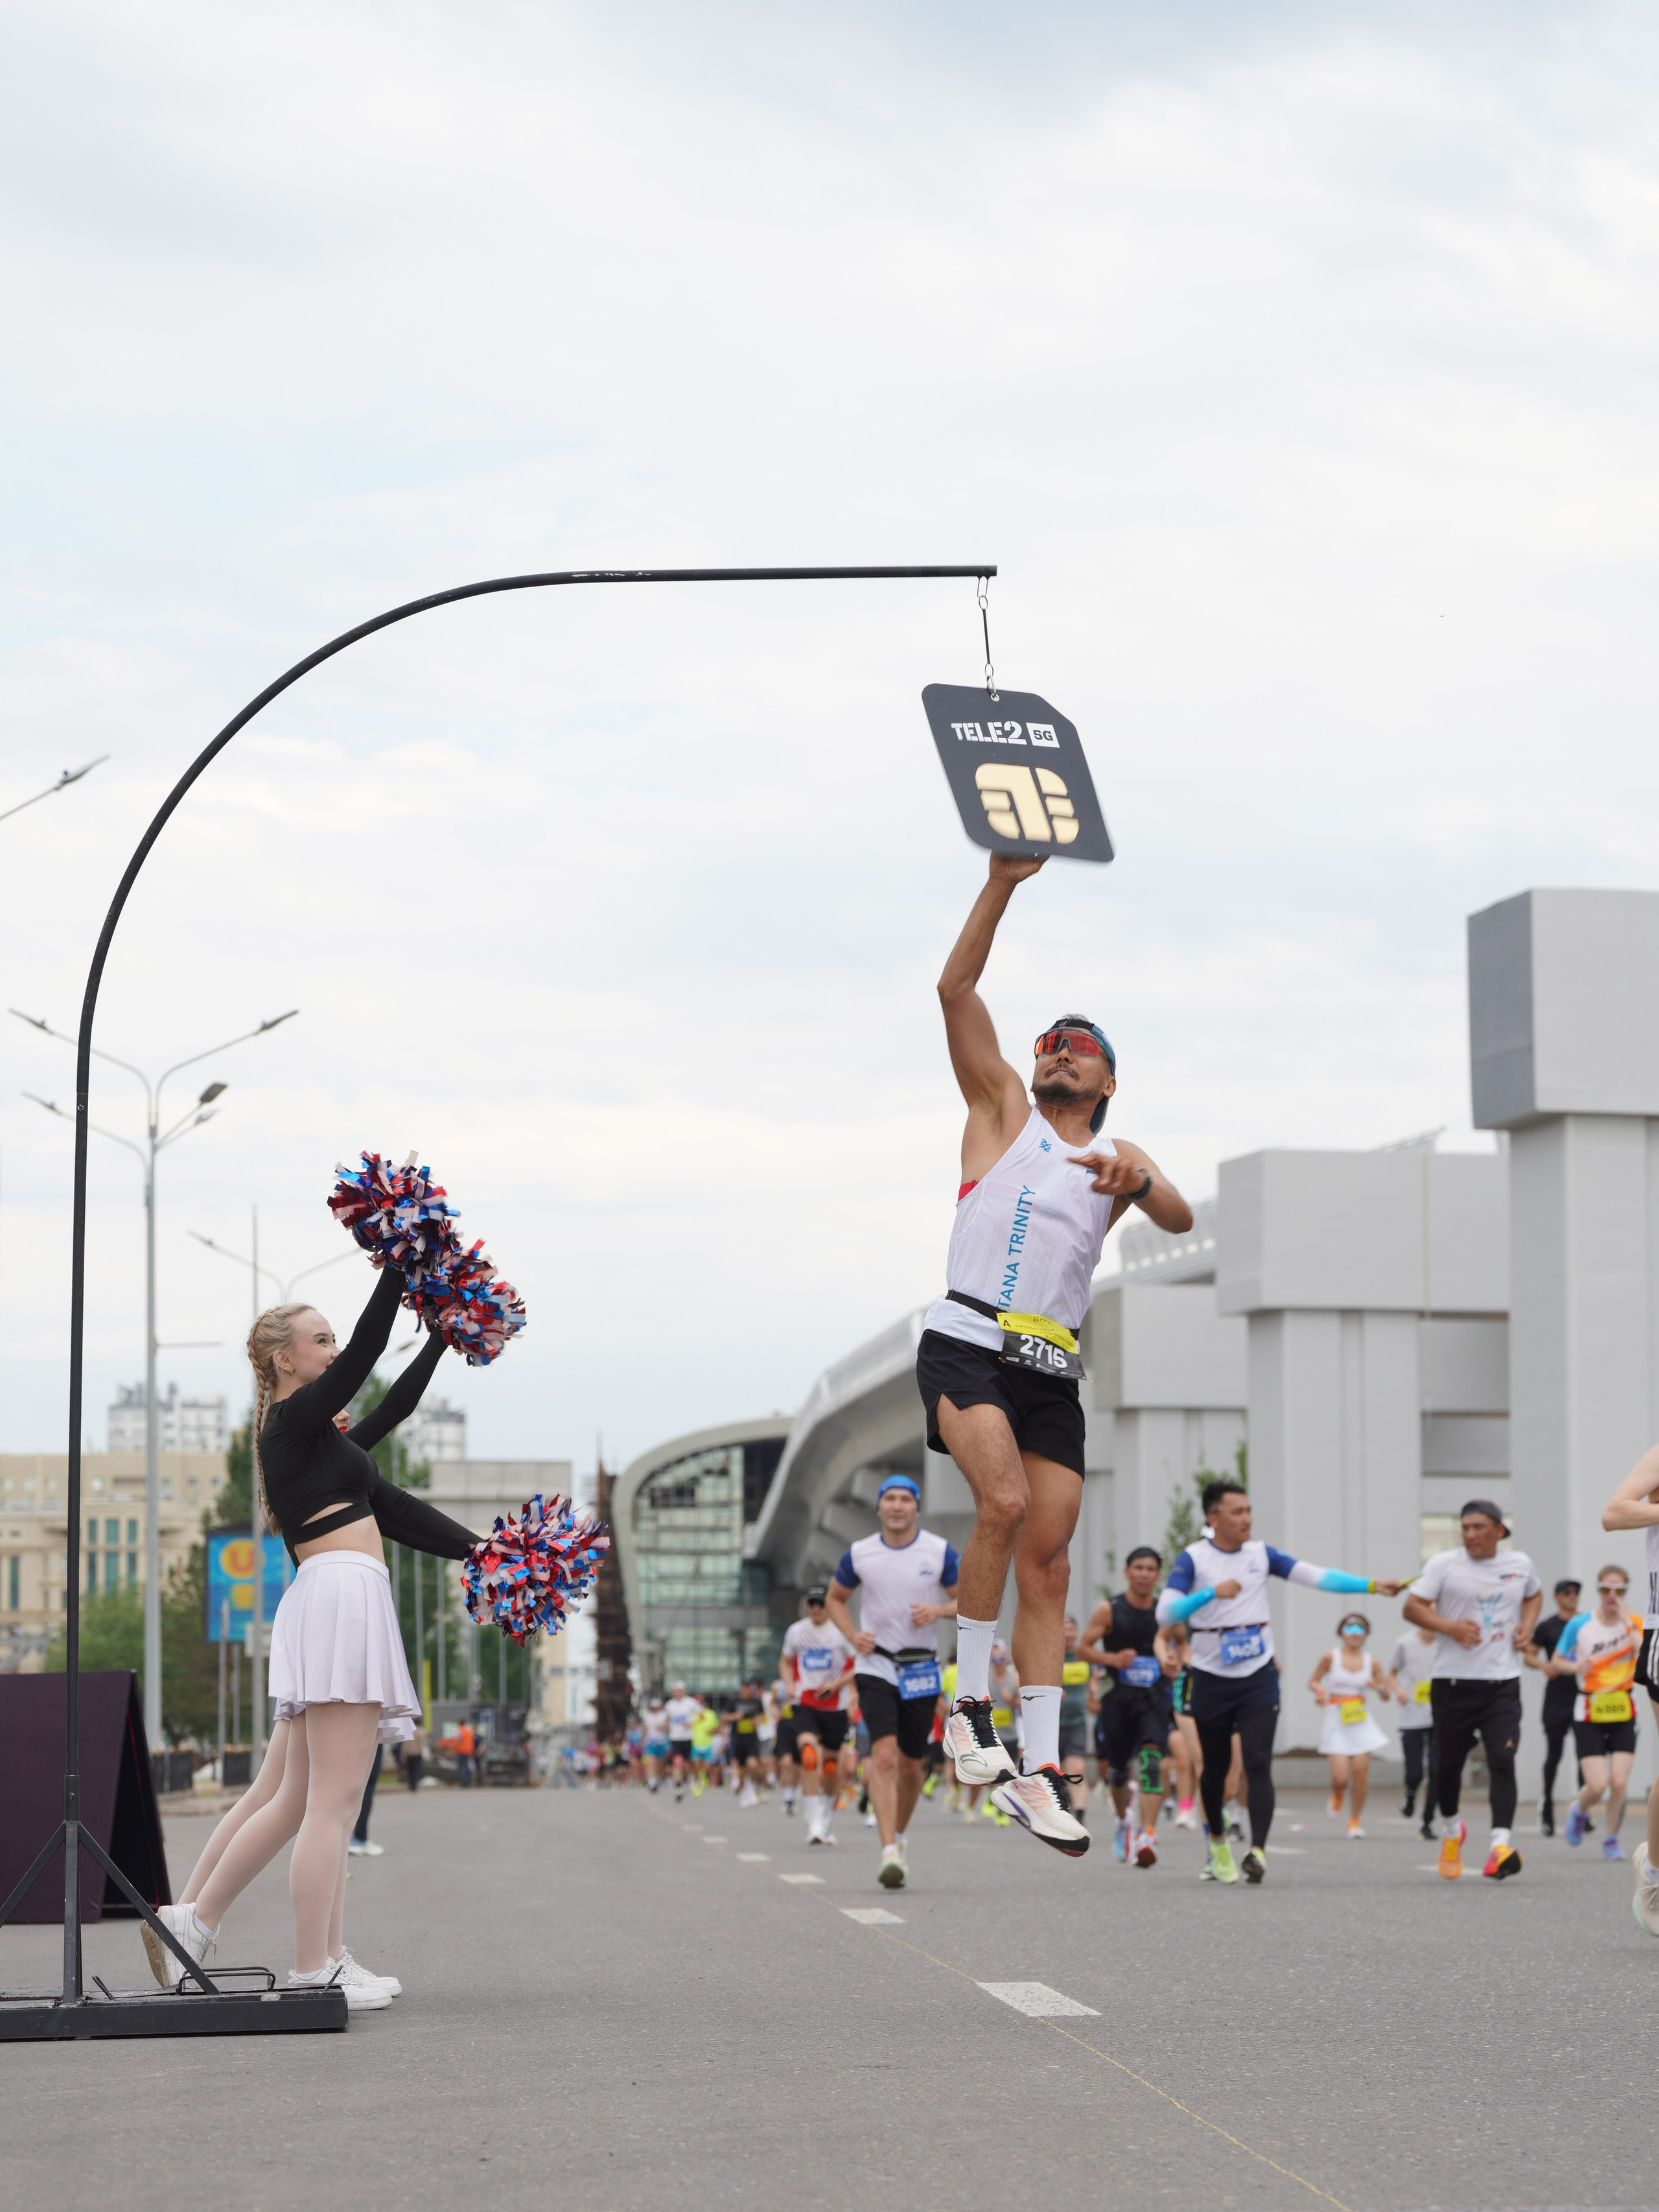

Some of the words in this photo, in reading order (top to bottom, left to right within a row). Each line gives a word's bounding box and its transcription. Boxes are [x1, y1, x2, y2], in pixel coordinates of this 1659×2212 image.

[951, 721, 1027, 745] TELE2
[1033, 730, 1054, 741] 5G
[1008, 1185, 1036, 1255] TRINITY
[1019, 1334, 1068, 1368] 2715
